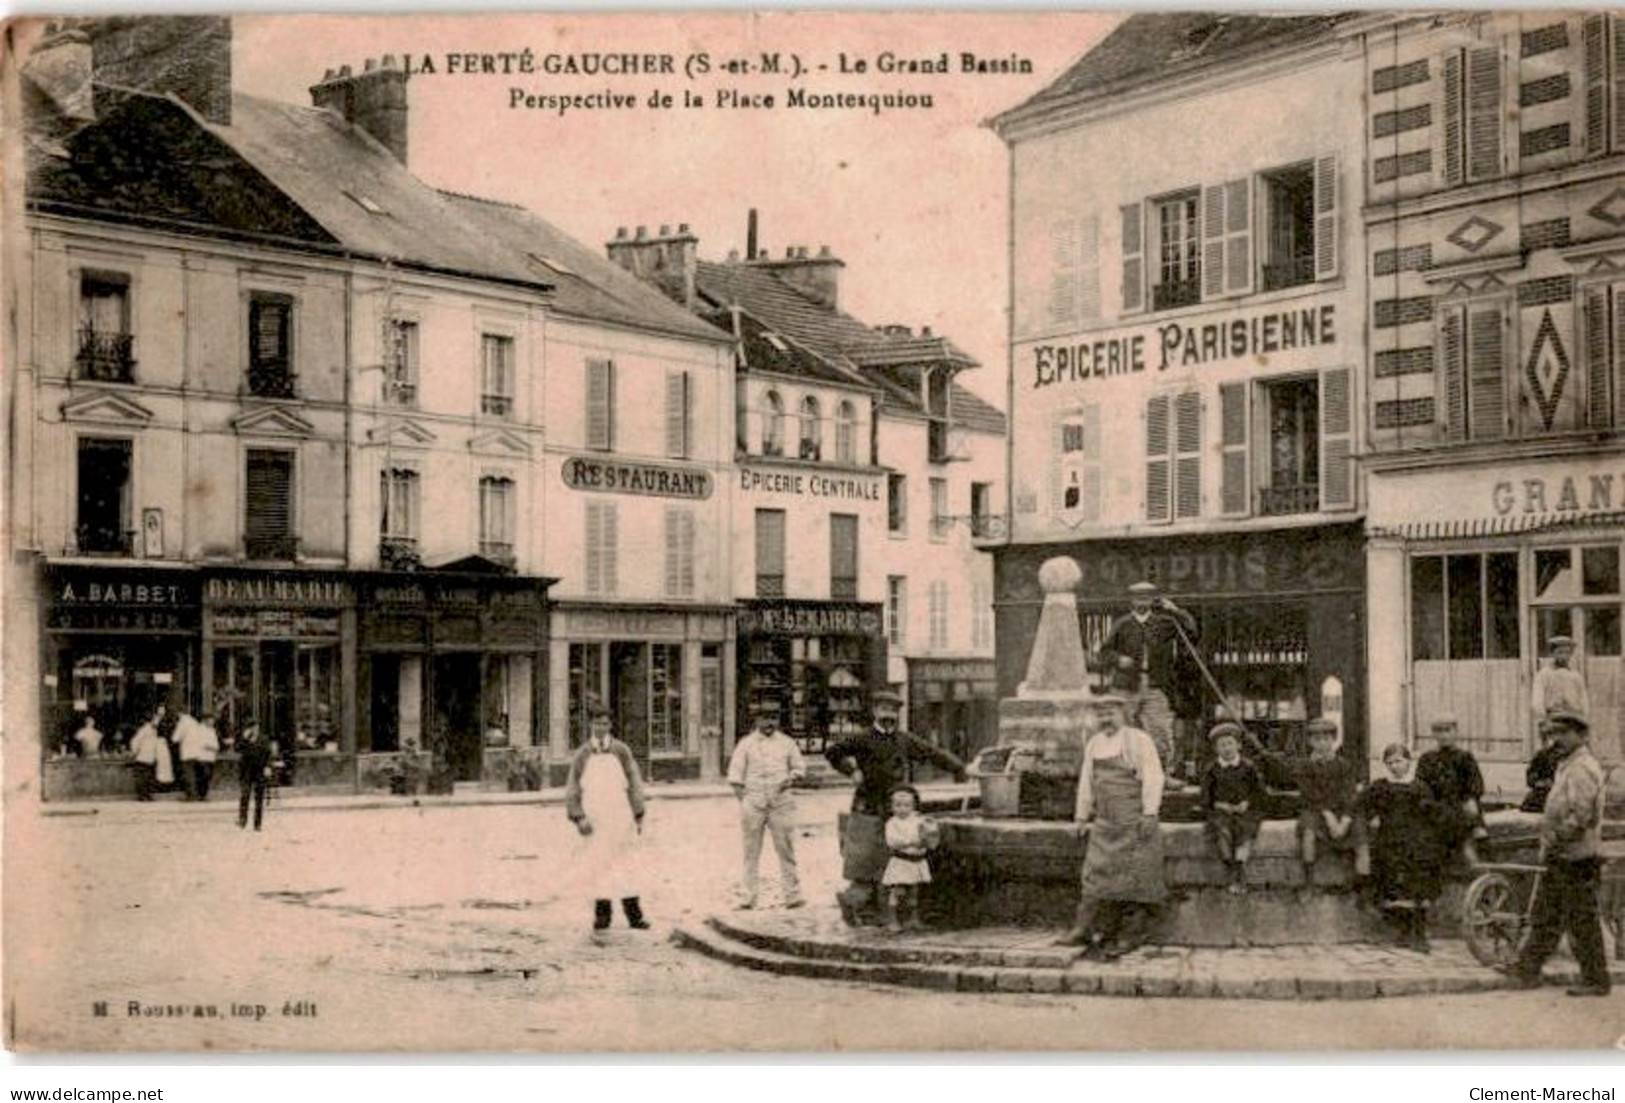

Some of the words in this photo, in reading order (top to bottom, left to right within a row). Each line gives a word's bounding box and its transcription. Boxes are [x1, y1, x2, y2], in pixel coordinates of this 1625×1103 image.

[1033, 335, 1146, 389] EPICERIE
[1157, 304, 1336, 372] PARISIENNE
[572, 460, 707, 496] RESTAURANT
[741, 469, 804, 496] EPICERIE
[809, 474, 880, 501] CENTRALE
[1492, 472, 1625, 516] GRAN
